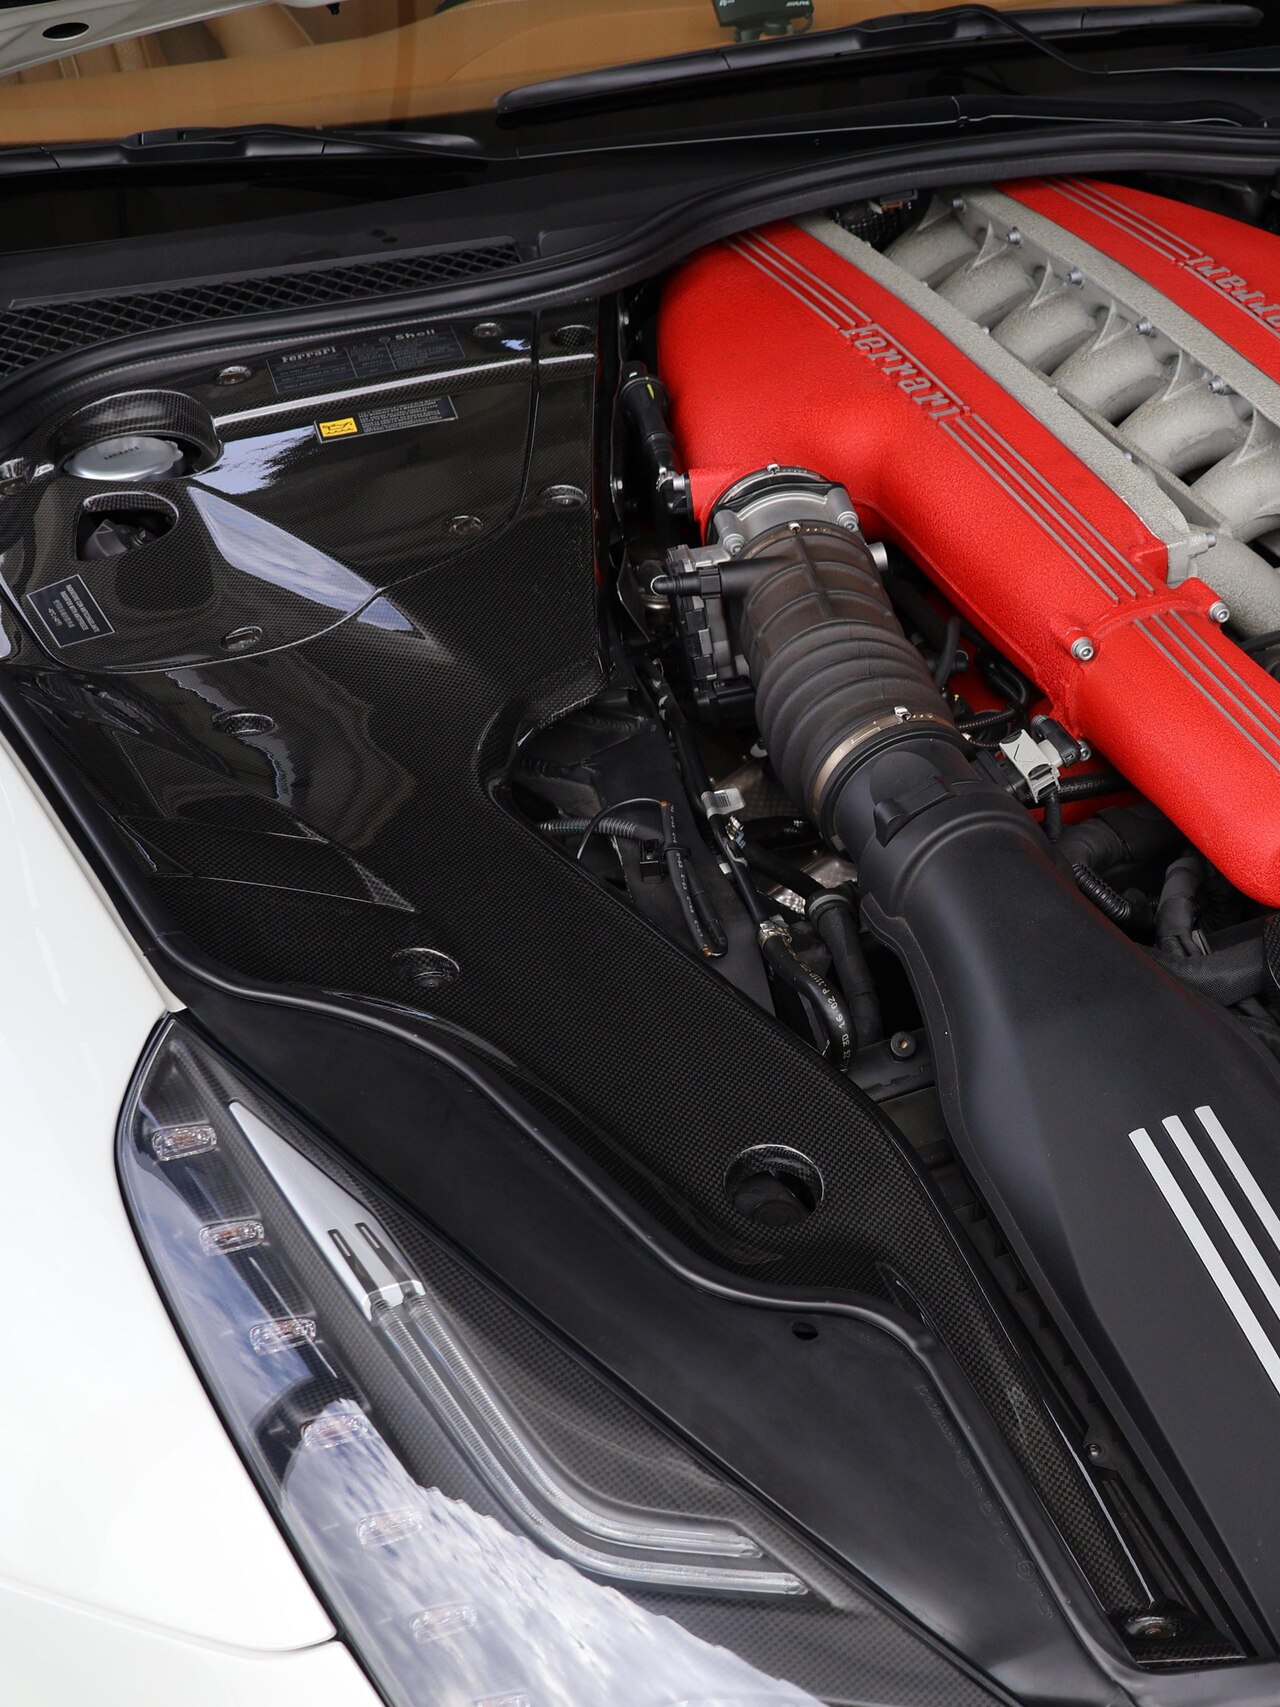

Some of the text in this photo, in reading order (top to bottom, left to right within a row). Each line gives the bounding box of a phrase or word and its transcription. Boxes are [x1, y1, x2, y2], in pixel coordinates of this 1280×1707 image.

[395, 329, 436, 341] Shell
[281, 346, 337, 363] Ferrari
[840, 323, 970, 419] Ferrari
